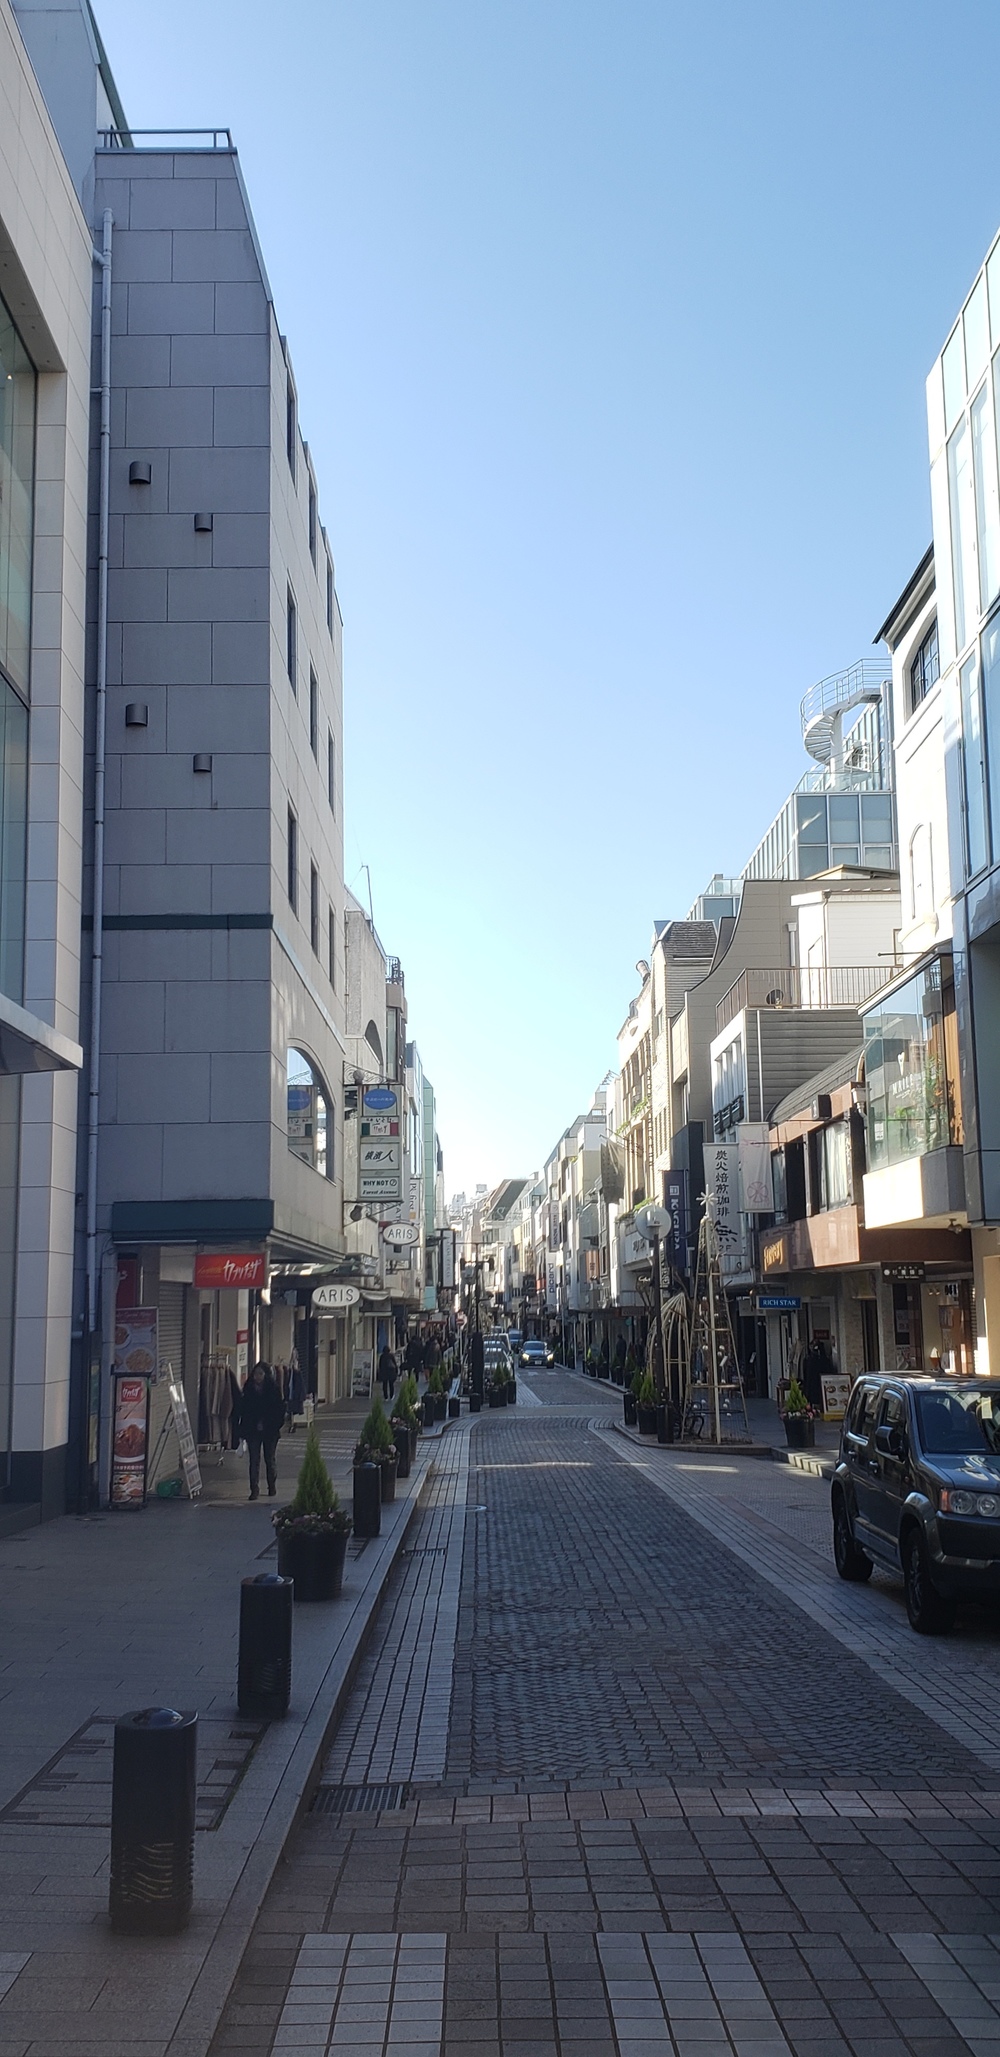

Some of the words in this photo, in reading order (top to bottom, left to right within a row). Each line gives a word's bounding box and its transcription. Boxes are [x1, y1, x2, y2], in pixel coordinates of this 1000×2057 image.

[715, 1150, 730, 1217] 炭火焙煎珈琲
[387, 1228, 414, 1240] ARIS
[318, 1288, 354, 1302] ARIS
